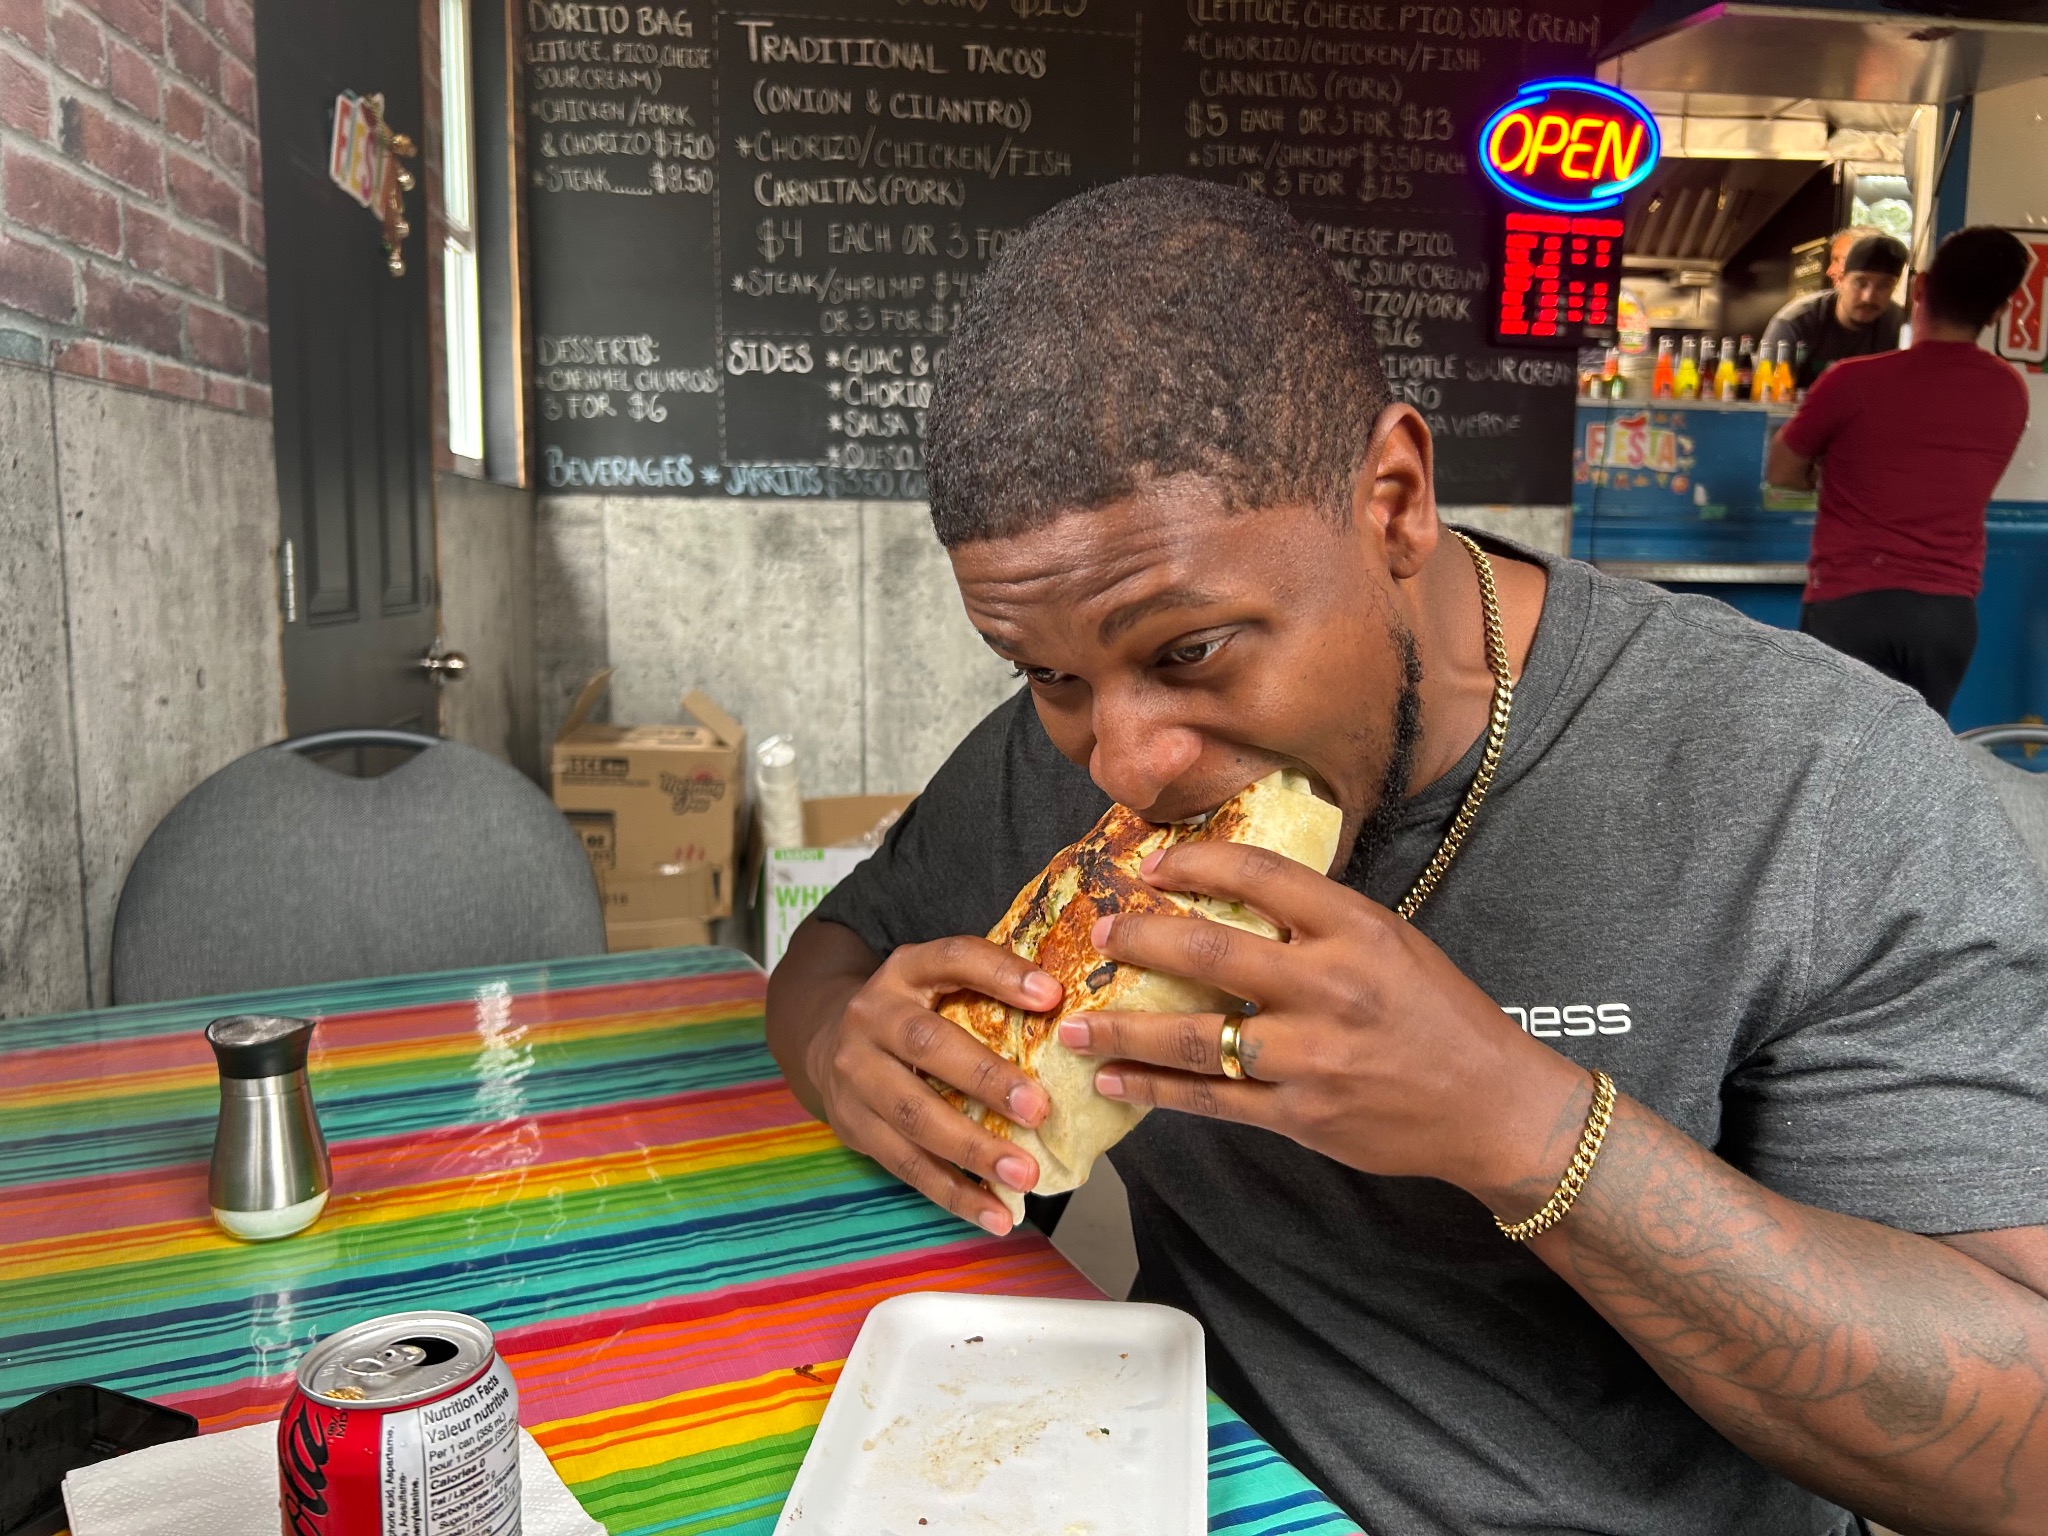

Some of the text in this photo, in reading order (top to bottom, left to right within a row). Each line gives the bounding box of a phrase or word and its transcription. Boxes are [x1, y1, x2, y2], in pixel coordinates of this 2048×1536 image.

[529, 1, 693, 38] DORITO BAG
[1470, 8, 1522, 39] SOUR
[734, 20, 1047, 79] TRADITIONAL TACOS
[1200, 68, 1403, 107] CARNITAS (PORK)
[753, 77, 852, 115] (ONION
[889, 92, 1032, 133] CILANTRO)
[1185, 100, 1455, 140] $5 EACH OR 3 FOR $13
[560, 131, 651, 156] CHORIZO
[1489, 112, 1645, 181] OPEN
[1272, 169, 1293, 197] 3
[1299, 171, 1346, 197] FOR
[1357, 173, 1413, 202] $15
[756, 216, 802, 263] $4
[827, 222, 892, 254] EACH
[902, 222, 938, 256] OR
[946, 221, 969, 259] 3
[819, 309, 850, 333] OR
[854, 305, 875, 330] 3
[880, 310, 922, 331] FOR
[1370, 317, 1423, 348] $16
[726, 337, 813, 375] SIDES
[841, 341, 903, 374] GUAC
[910, 343, 930, 376] &
[566, 393, 618, 419] FOR
[626, 392, 668, 422] $6
[844, 408, 909, 438] SALSA
[545, 445, 694, 488] BEVERAGES
[423, 1394, 478, 1425] Nutrition
[476, 1375, 499, 1399] Facts
[426, 1417, 471, 1443] Valeur
[474, 1388, 509, 1424] nutritive
[429, 1448, 447, 1461] Per
[458, 1436, 475, 1450] can
[429, 1459, 453, 1475] pour
[431, 1465, 477, 1489] Calories
[431, 1497, 446, 1508] Fat
[431, 1489, 489, 1521] Carbohydrate
